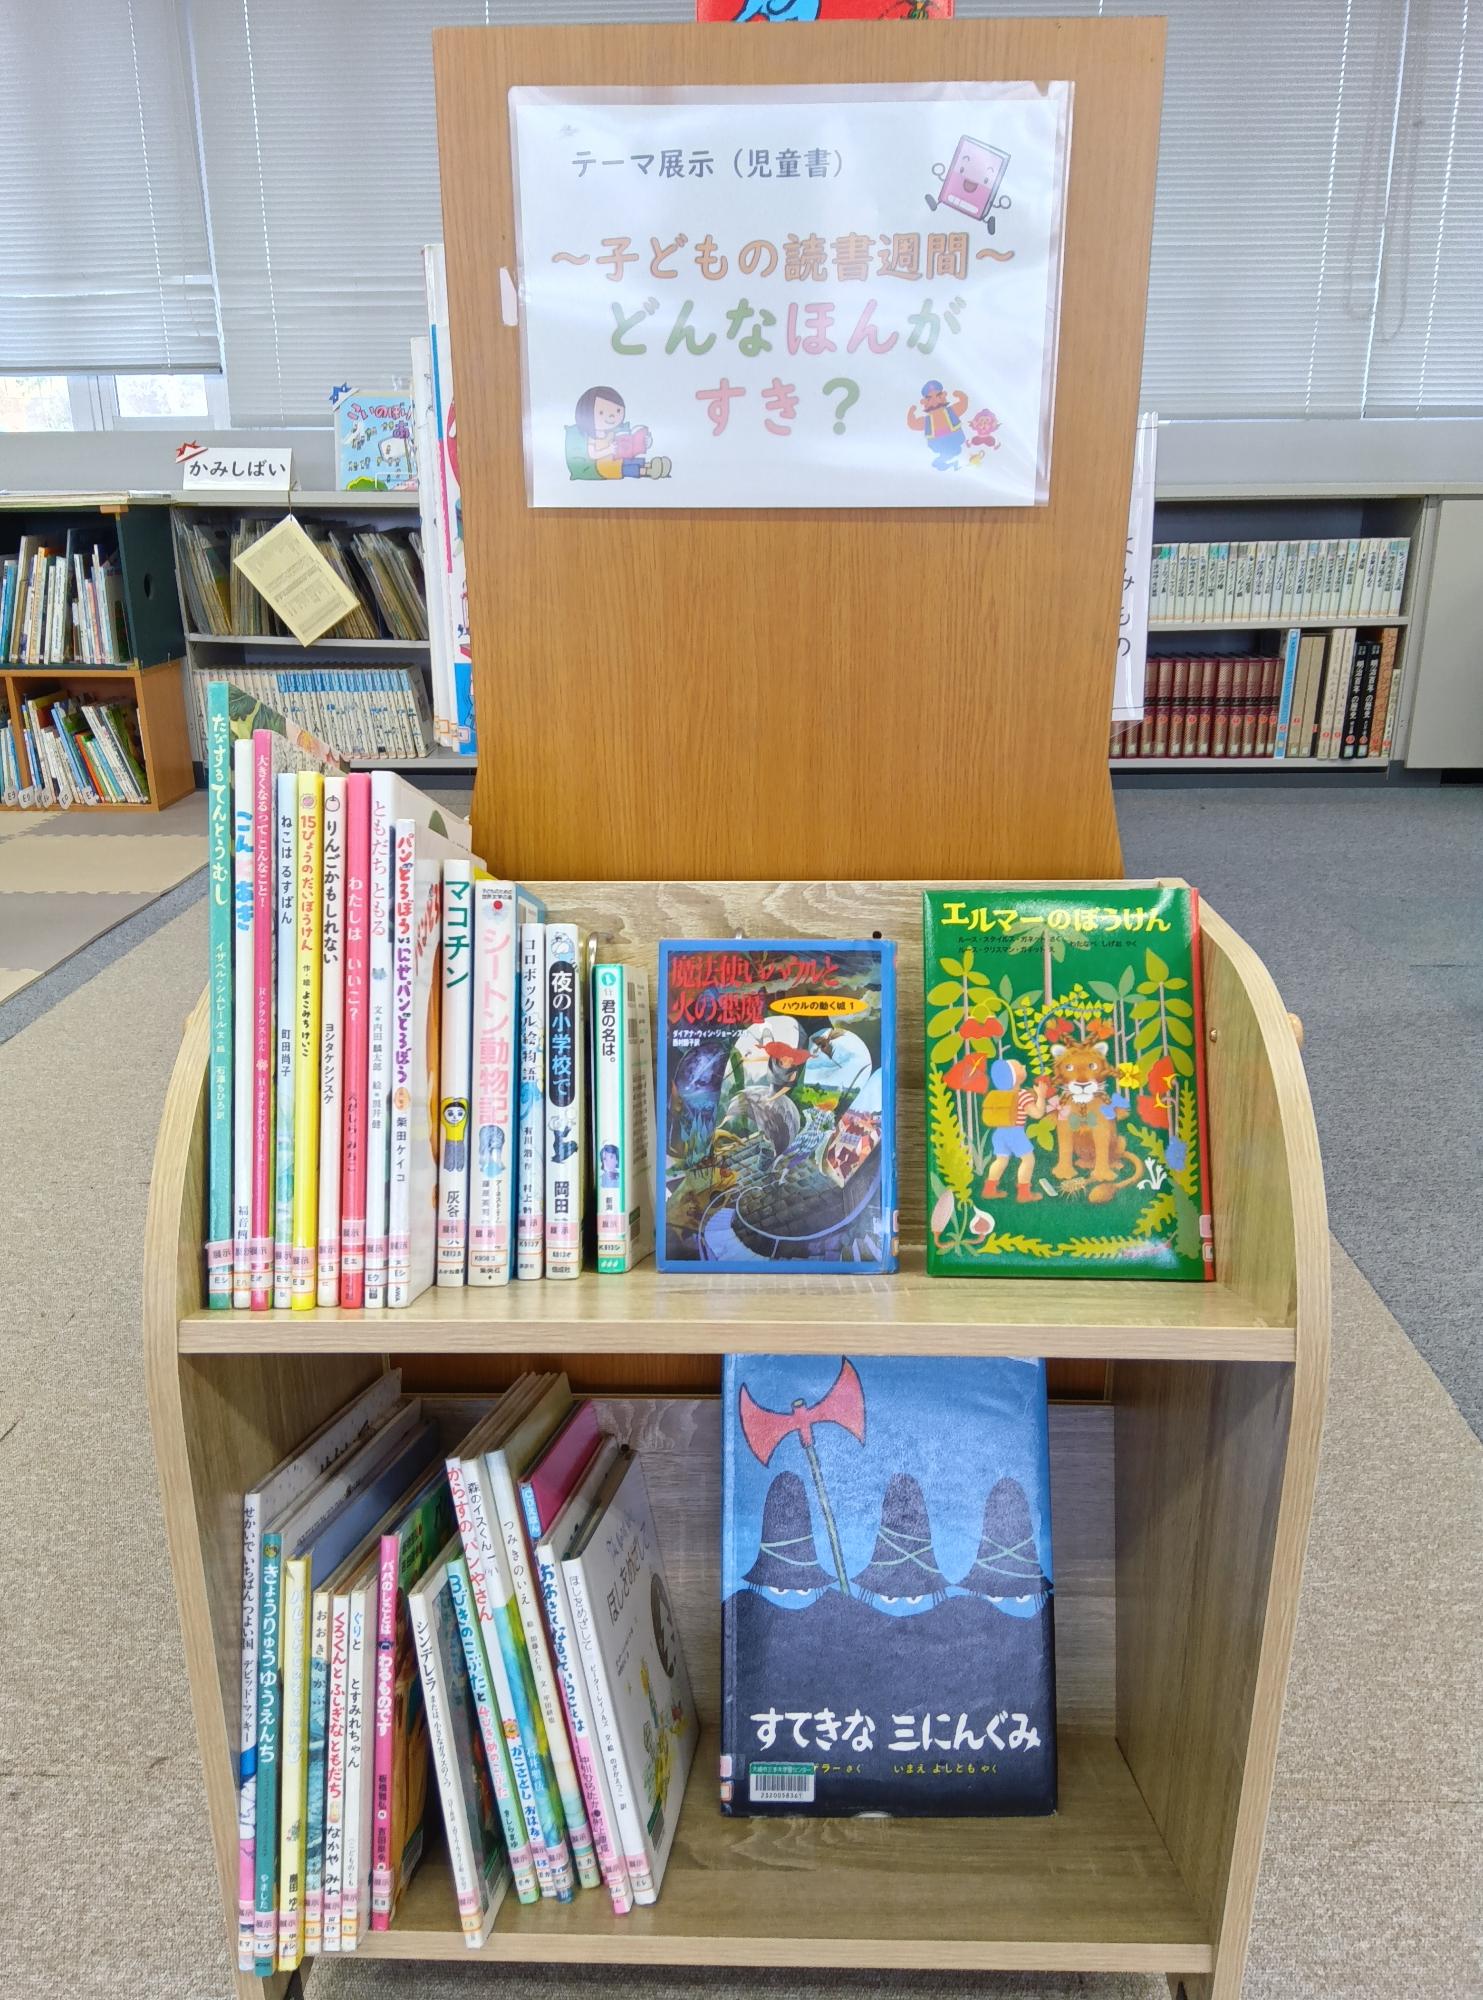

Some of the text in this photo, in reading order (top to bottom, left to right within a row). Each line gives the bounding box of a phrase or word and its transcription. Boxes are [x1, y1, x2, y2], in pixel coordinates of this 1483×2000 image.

[572, 148, 847, 178] テーマ展示（児童書）
[610, 297, 969, 357] どんなほんが
[189, 459, 287, 479] かみしばい
[211, 714, 229, 906] たびするてんとうむし
[323, 820, 340, 965] りんごかもしれない
[372, 801, 387, 937] ともだち ともる
[444, 880, 470, 989] マコチン
[940, 902, 1172, 933] エルマーのぼうけん
[478, 928, 511, 1125] シートン動物記
[551, 970, 573, 1096] 夜の小学校で
[601, 999, 616, 1063] 君の名は。
[671, 992, 765, 1025] 火の悪魔
[281, 1029, 291, 1077] 町田尚子
[324, 1023, 335, 1105] ヨシタケシンスケ
[396, 1117, 408, 1182] 柴田ケイコ
[503, 1520, 530, 1605] つみきのいえ
[258, 1564, 278, 1763] きょうりゅうゆうえんち
[416, 1621, 437, 1691] シンデレラ
[376, 1655, 394, 1738] わるものです
[750, 1707, 1042, 1752] すてきな 三にんぐみ
[894, 1763, 926, 1774] いまえ
[933, 1763, 975, 1774] よしとも
